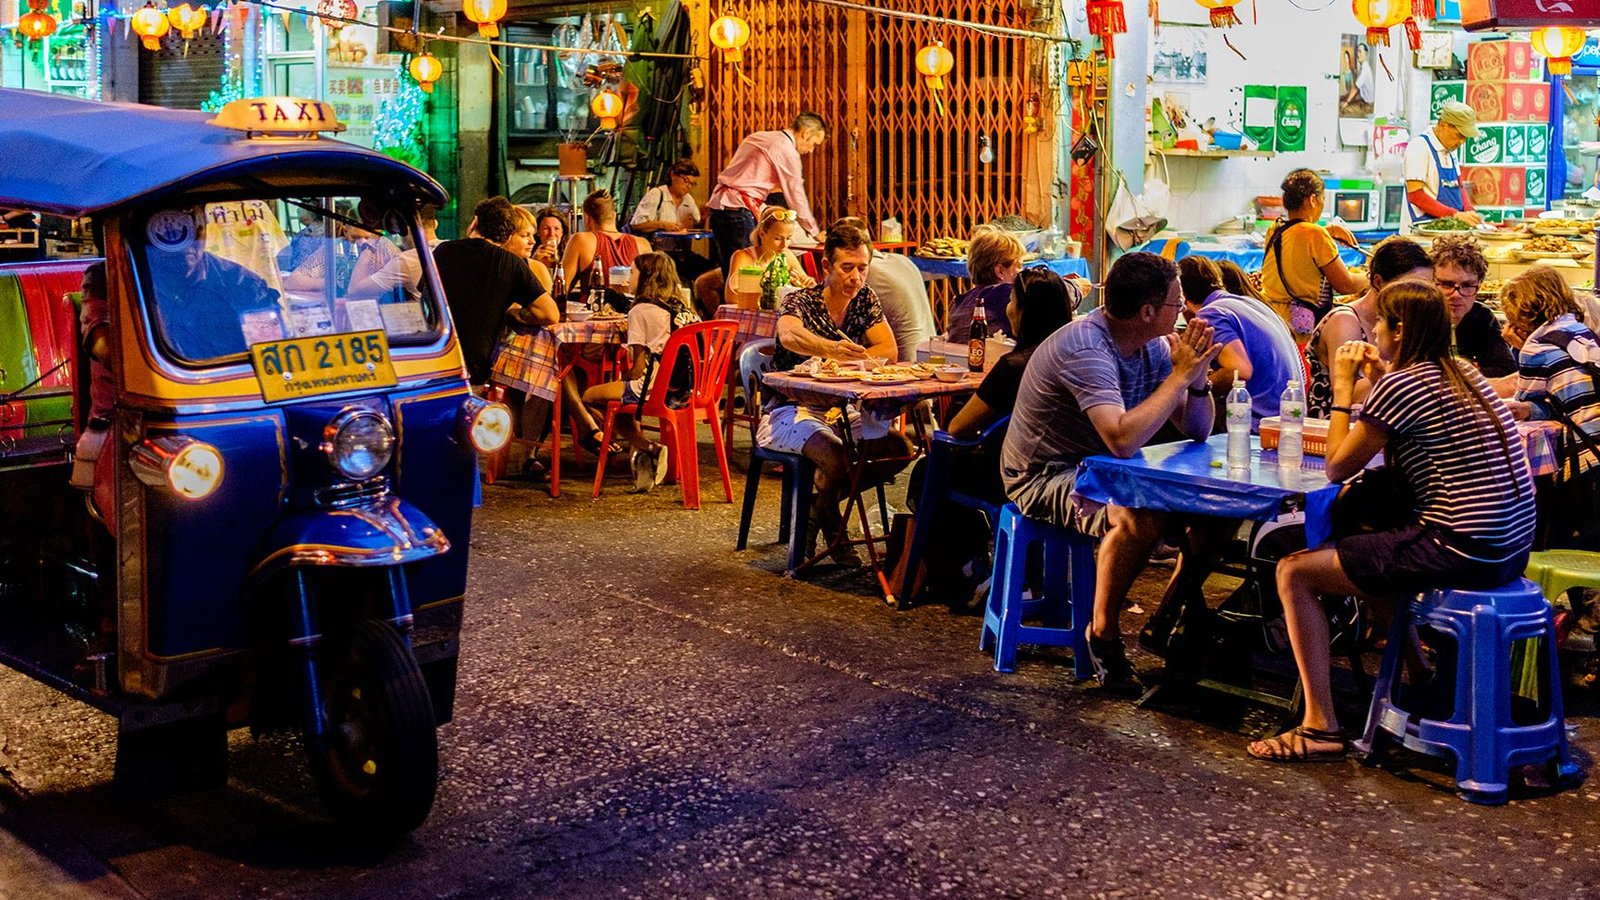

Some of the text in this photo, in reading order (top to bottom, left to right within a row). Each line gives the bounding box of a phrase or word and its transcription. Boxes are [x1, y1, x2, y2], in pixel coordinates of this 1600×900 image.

[251, 102, 326, 121] TAXI
[1281, 117, 1301, 129] Chang
[1470, 136, 1497, 155] Chang
[261, 334, 383, 375] สก 2185
